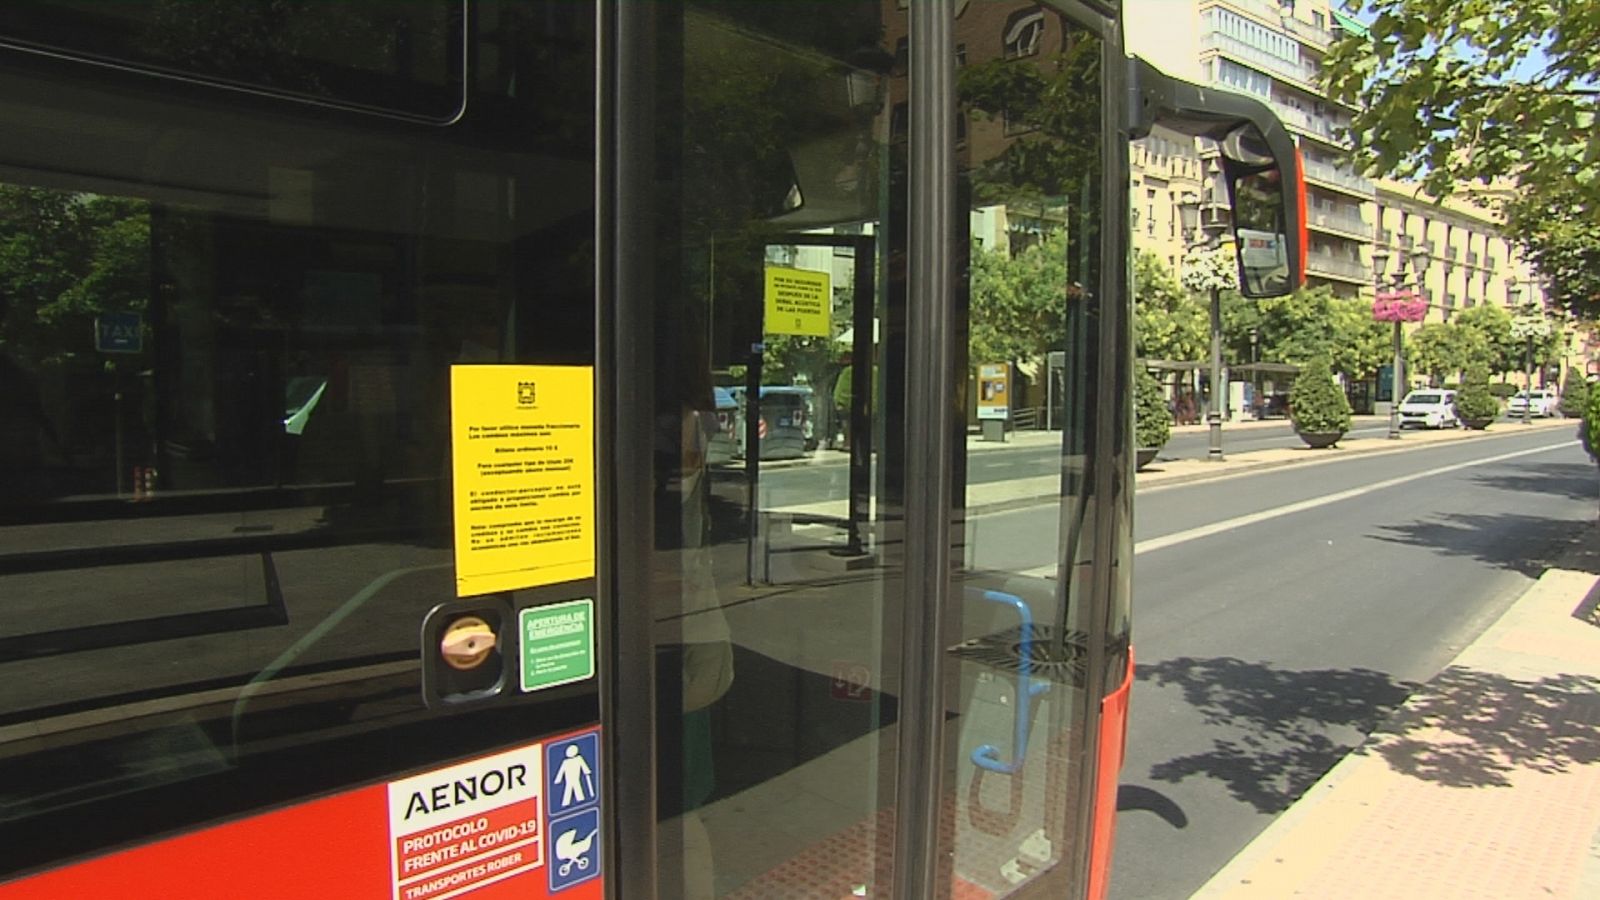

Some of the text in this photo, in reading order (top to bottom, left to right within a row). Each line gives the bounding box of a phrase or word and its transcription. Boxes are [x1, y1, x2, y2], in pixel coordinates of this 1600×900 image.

[404, 764, 526, 820] AENOR
[403, 817, 488, 855] PROTOCOLO
[404, 819, 536, 873] FRENTE AL COVID-19
[406, 852, 523, 900] TRANSPORTES ROBER
